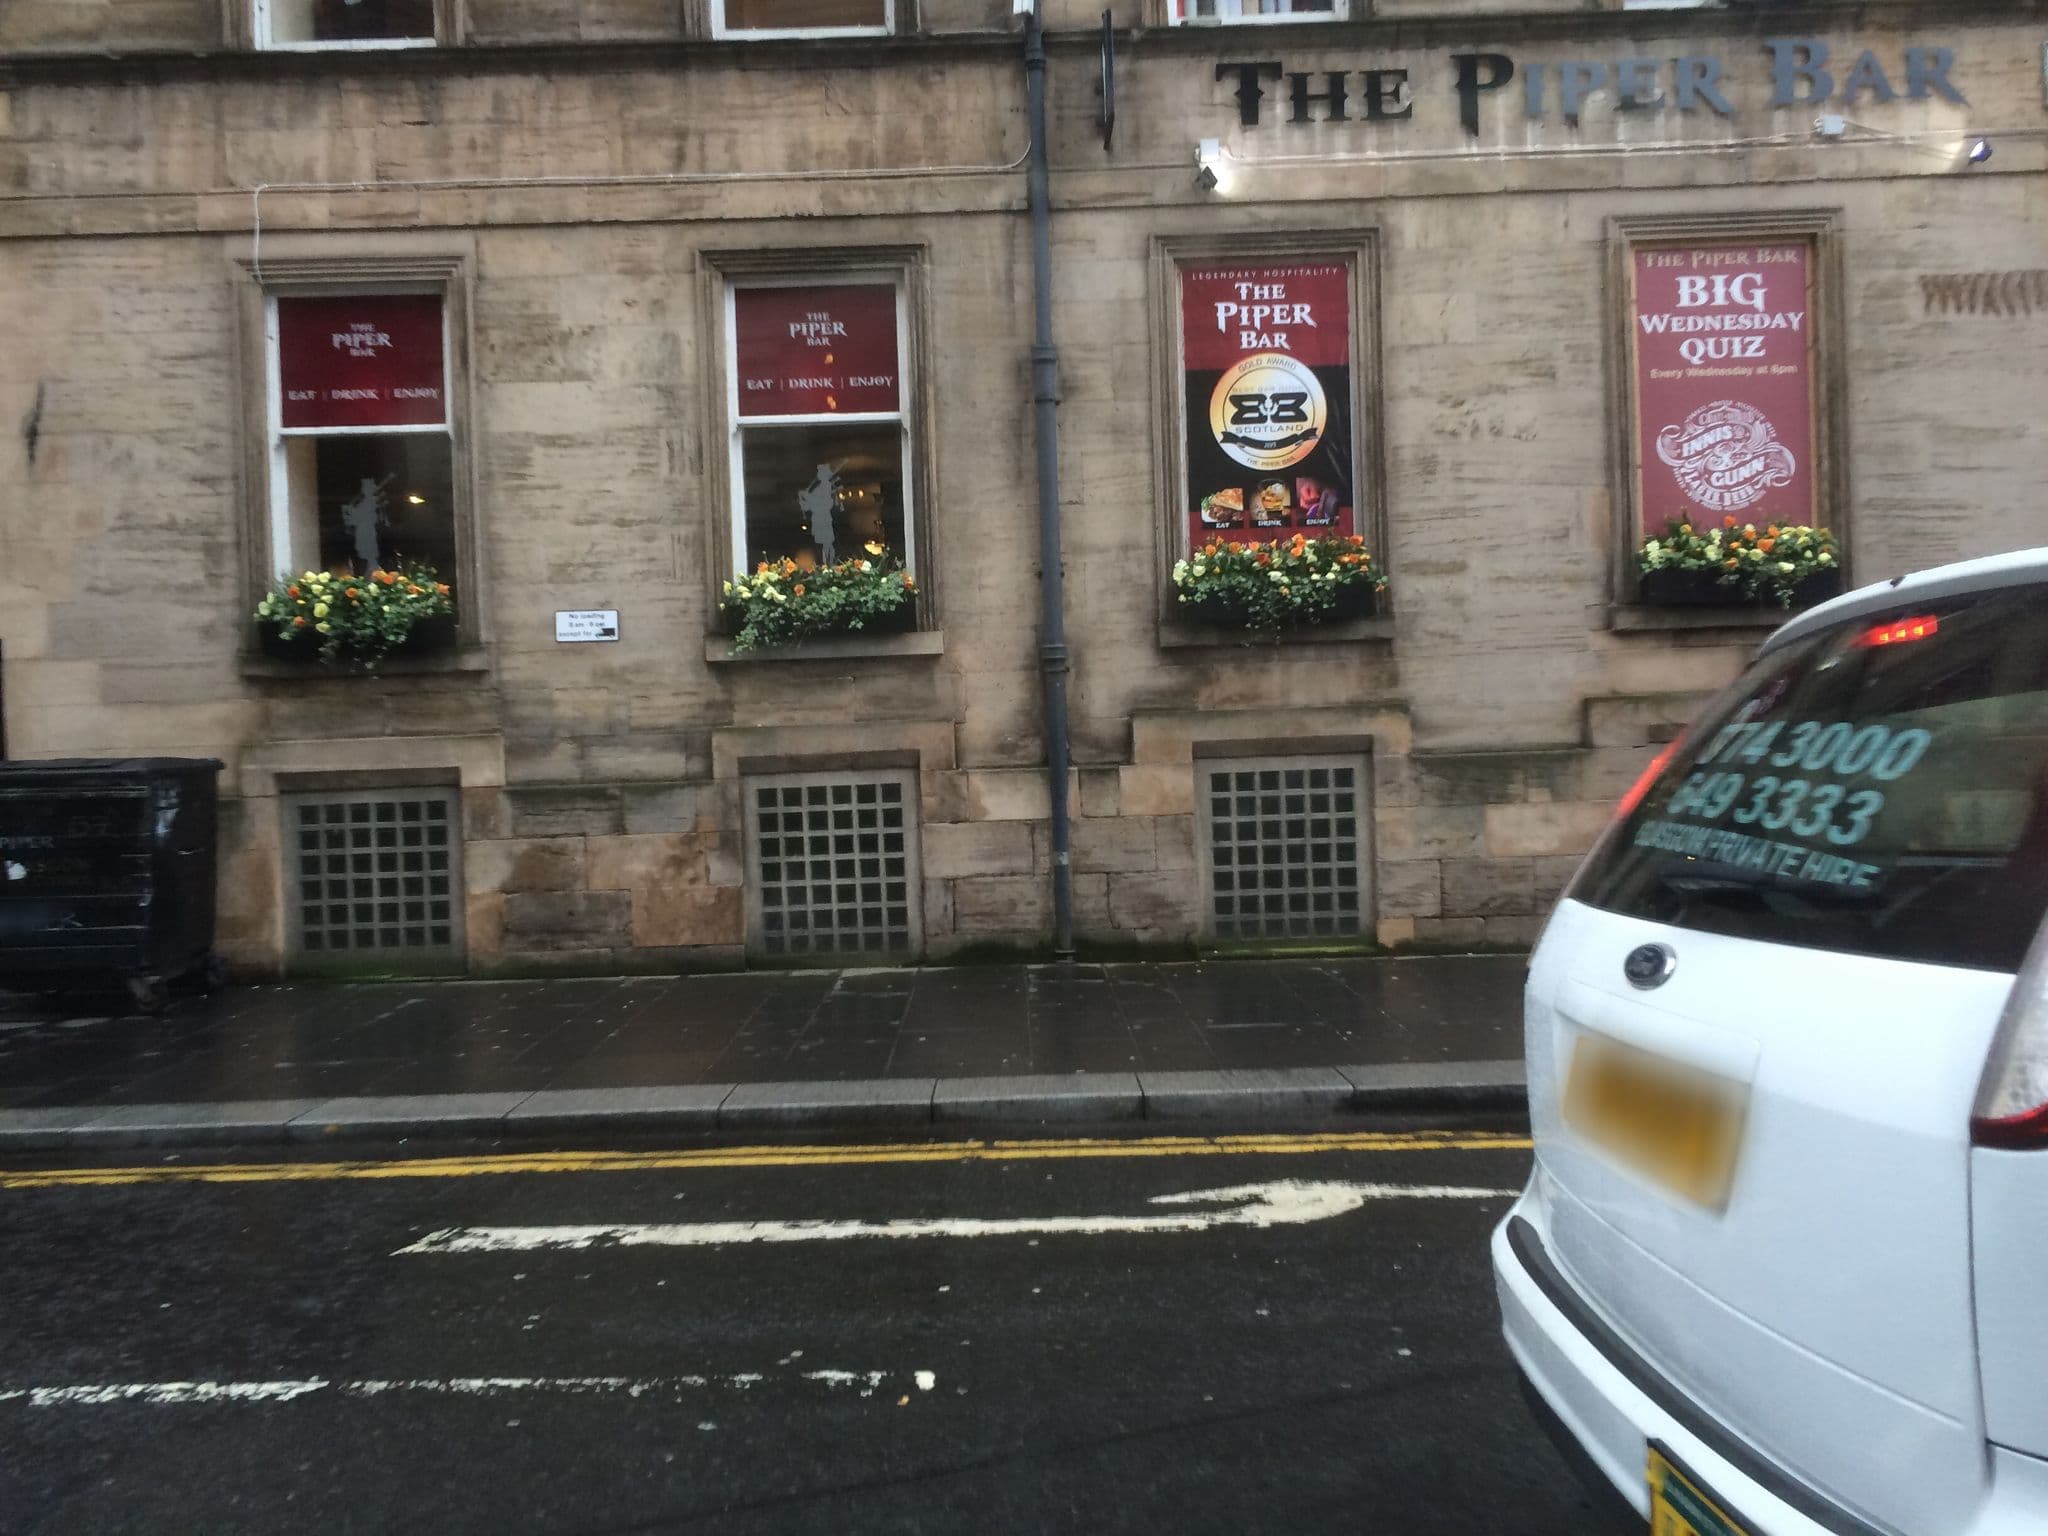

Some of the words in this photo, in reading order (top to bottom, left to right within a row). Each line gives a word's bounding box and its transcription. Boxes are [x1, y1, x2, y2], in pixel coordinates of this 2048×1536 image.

[1214, 60, 1414, 127] THE
[1449, 52, 1735, 136] PIPER
[1764, 39, 1971, 110] BAR
[1643, 252, 1685, 268] THE
[1691, 250, 1750, 269] PIPER
[1756, 248, 1798, 265] BAR
[1192, 270, 1257, 281] LEGENDARY
[1263, 267, 1339, 279] HOSPITALITY
[1234, 281, 1287, 301] THE
[1675, 272, 1769, 313] BIG
[806, 312, 831, 322] THE
[1214, 302, 1318, 333] PIPER
[1639, 311, 1805, 335] WEDNESDAY
[789, 321, 848, 339] PIPER
[1239, 330, 1291, 351] BAR
[331, 332, 394, 350] PIPER
[1679, 335, 1767, 365] QUIZ
[1238, 359, 1263, 372] GOLD
[1266, 357, 1298, 370] AWARD
[1650, 368, 1684, 380] Every
[1686, 366, 1753, 378] Wednesday
[746, 378, 774, 391] EAT
[788, 376, 834, 390] DRINK
[849, 375, 893, 389] ENJOY
[288, 389, 317, 401] EAT
[1235, 424, 1304, 435] SCOTLAND
[1681, 425, 1734, 458] INNIS
[1711, 455, 1766, 488] GUNN
[1771, 720, 1932, 781] 3000
[1733, 775, 1885, 845] 3333
